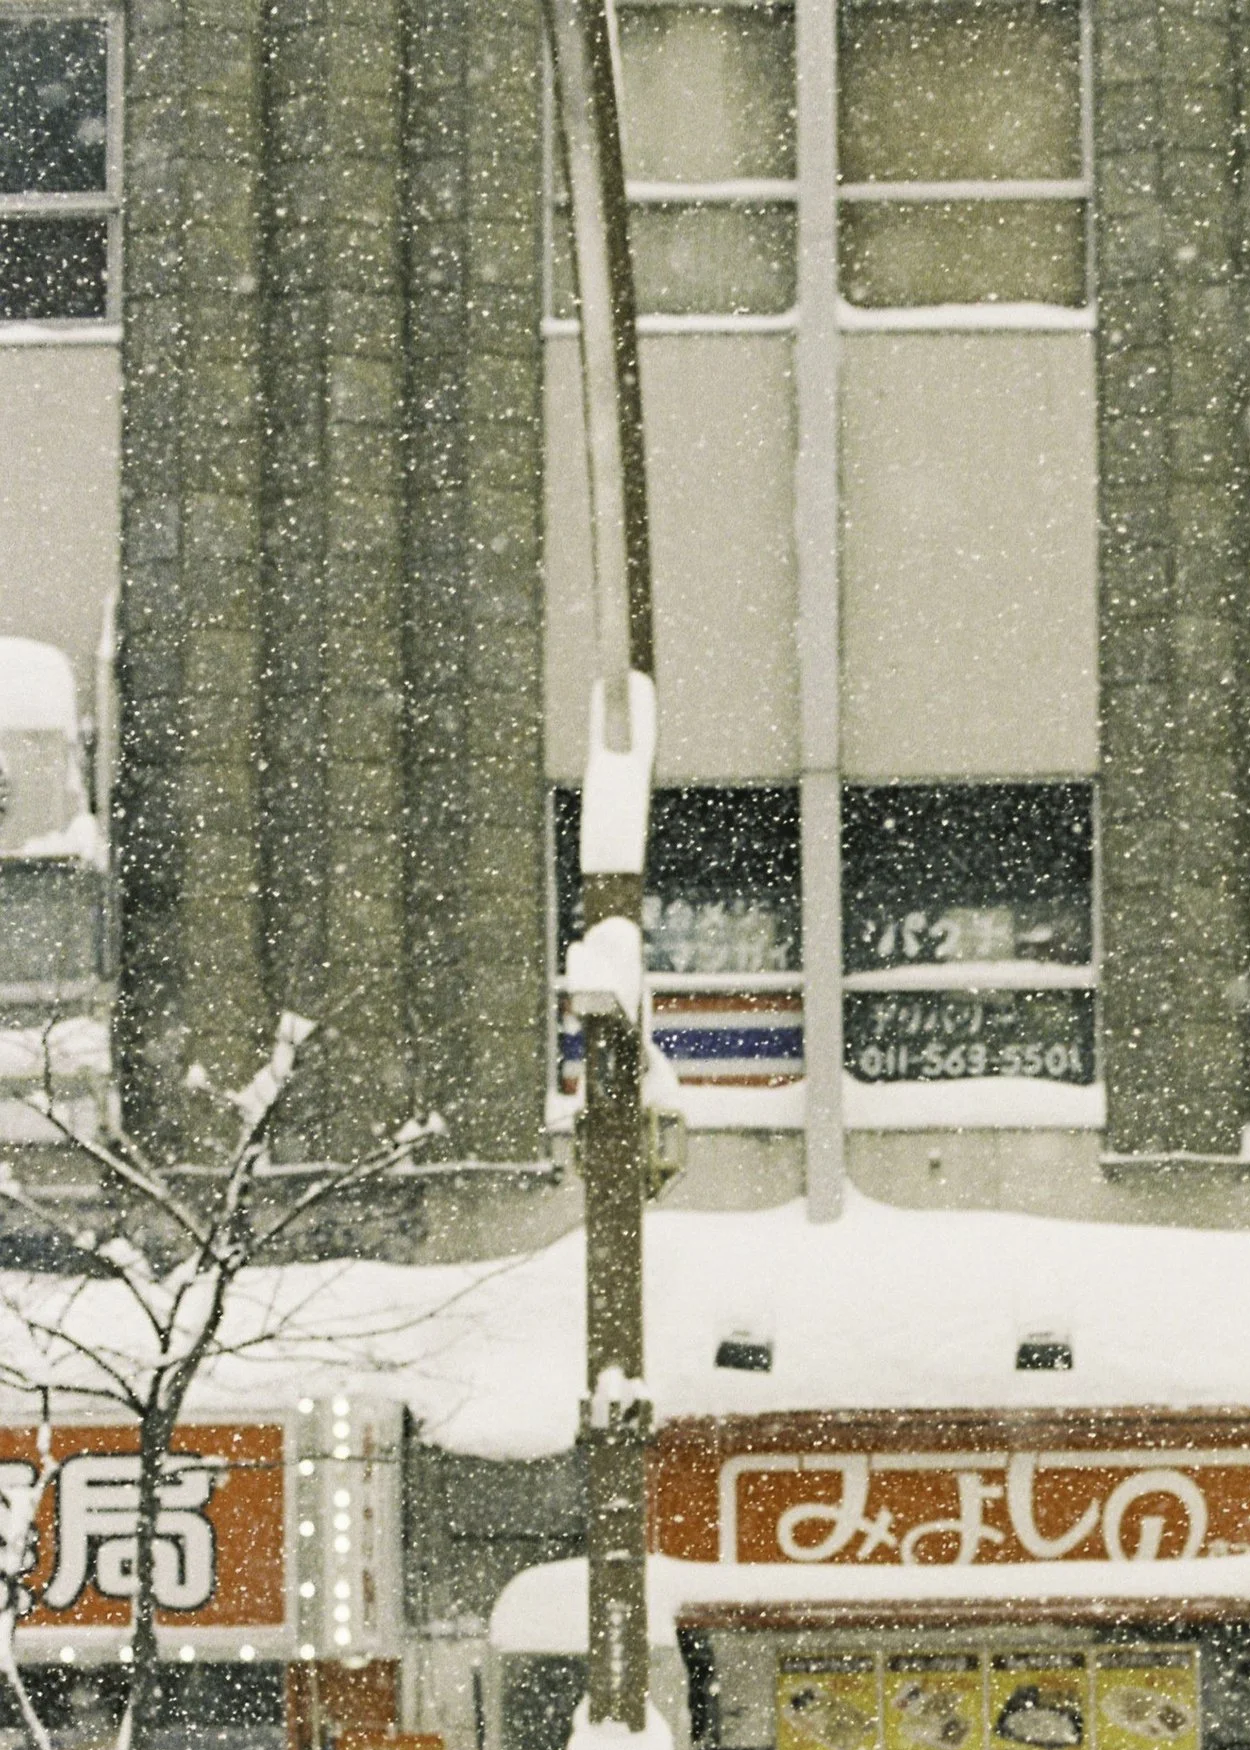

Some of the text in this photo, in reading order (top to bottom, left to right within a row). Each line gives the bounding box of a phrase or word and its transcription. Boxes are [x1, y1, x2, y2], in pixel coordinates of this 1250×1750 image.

[0, 1452, 217, 1612] 局
[777, 1450, 1208, 1566] みよしの
